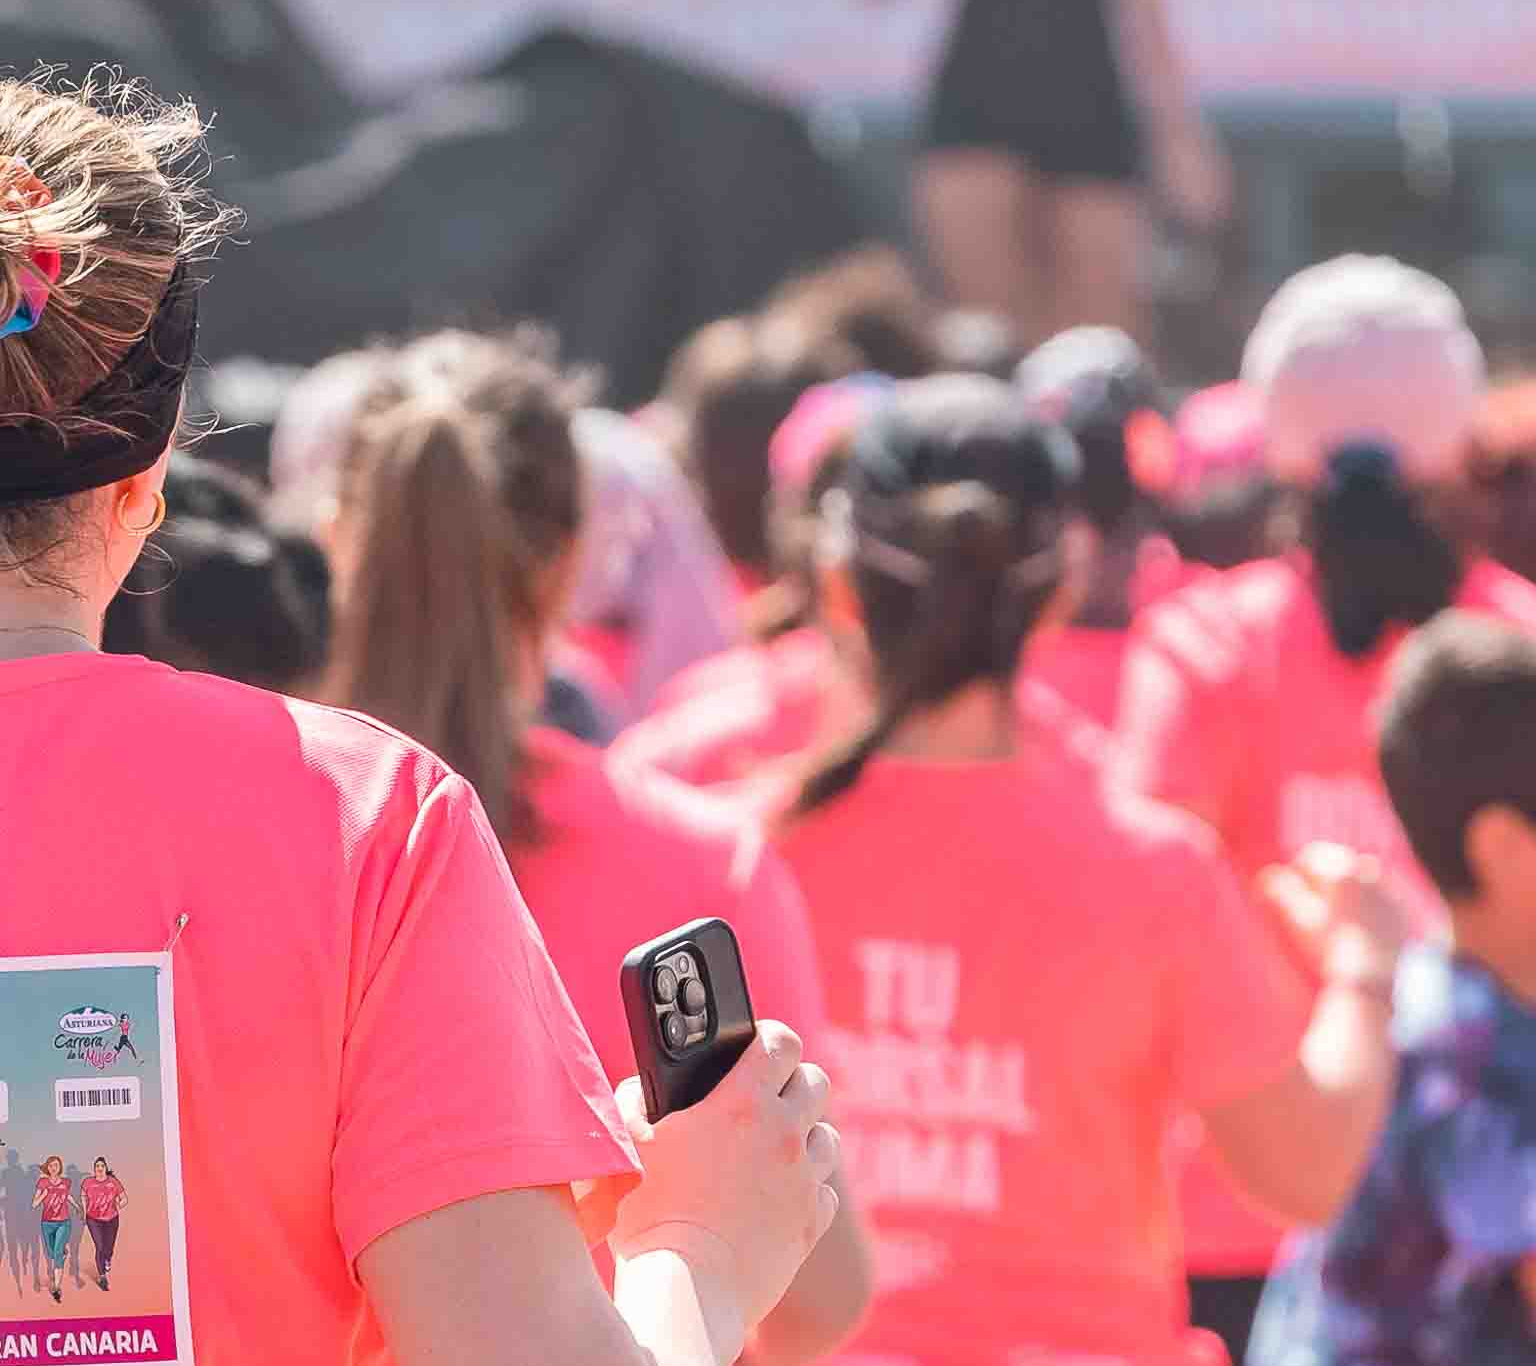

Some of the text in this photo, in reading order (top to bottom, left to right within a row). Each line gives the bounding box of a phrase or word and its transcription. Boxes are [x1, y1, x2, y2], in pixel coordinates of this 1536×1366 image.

[858, 940, 960, 1038] TU
[64, 1019, 114, 1029] ASTURIANA
[54, 1034, 104, 1049] Carrera
[840, 1132, 999, 1211] UMA
[47, 1330, 158, 1358] CANARIA
